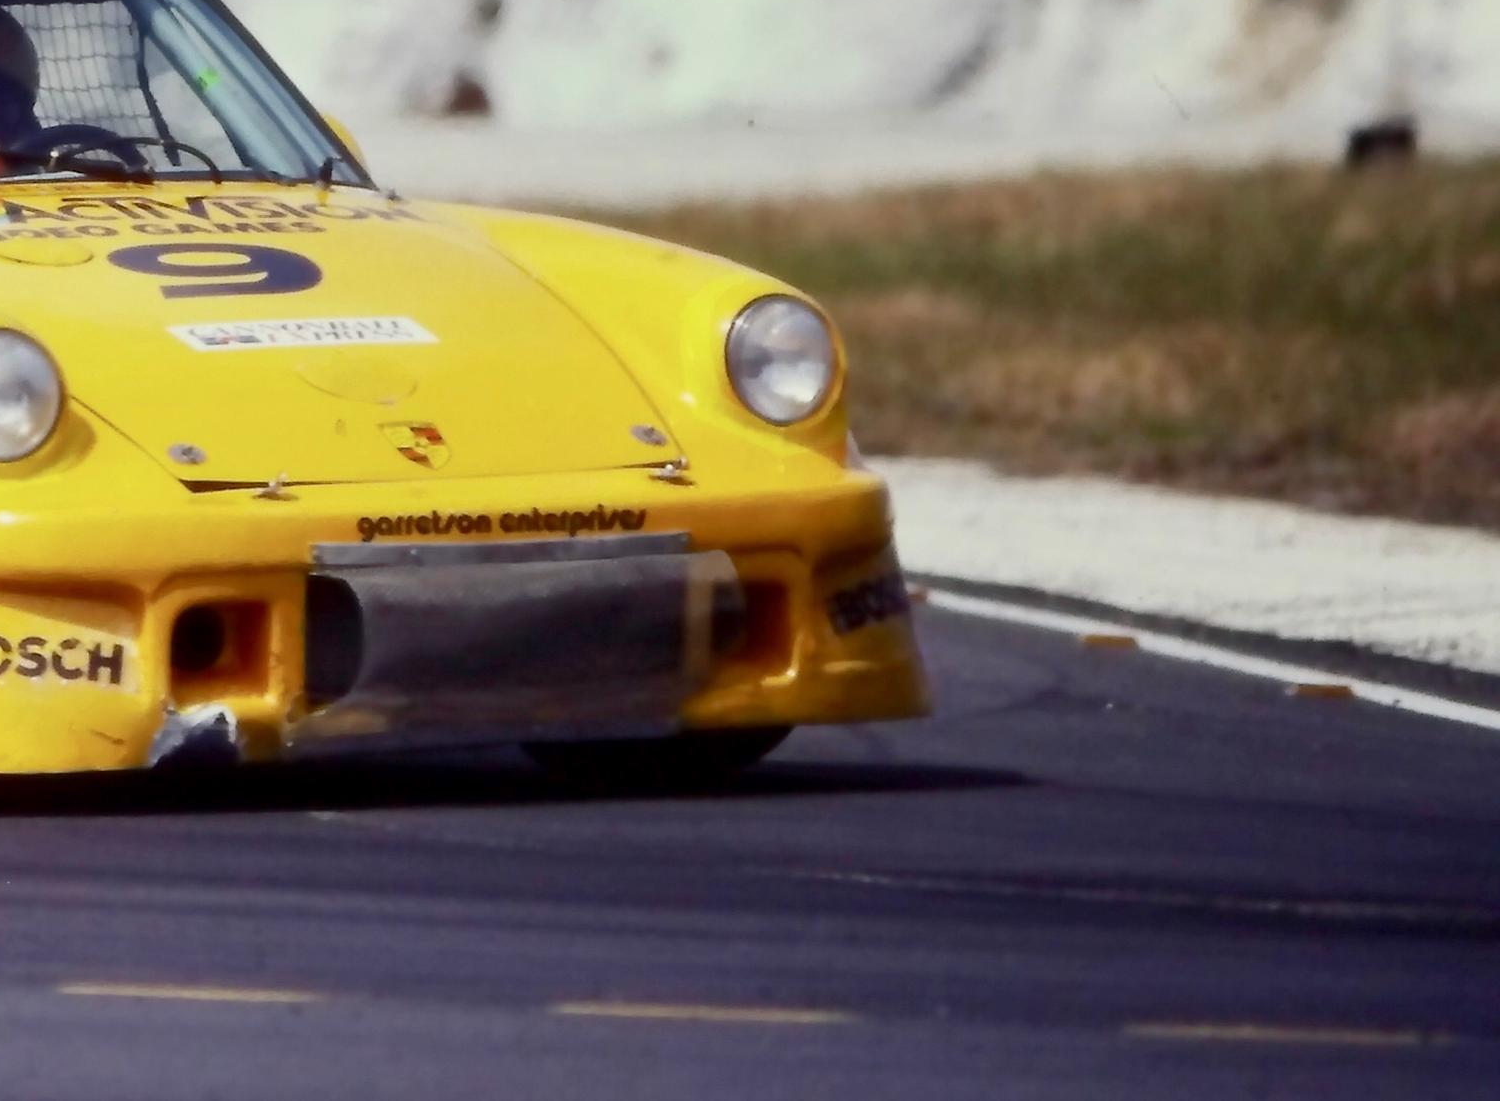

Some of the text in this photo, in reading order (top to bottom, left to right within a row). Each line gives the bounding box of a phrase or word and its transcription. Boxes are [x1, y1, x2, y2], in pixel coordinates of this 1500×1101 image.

[4, 195, 425, 223] ACTIVISION
[132, 221, 327, 235] GAMES
[107, 243, 323, 298] 9
[357, 504, 647, 542] garretson enterprises
